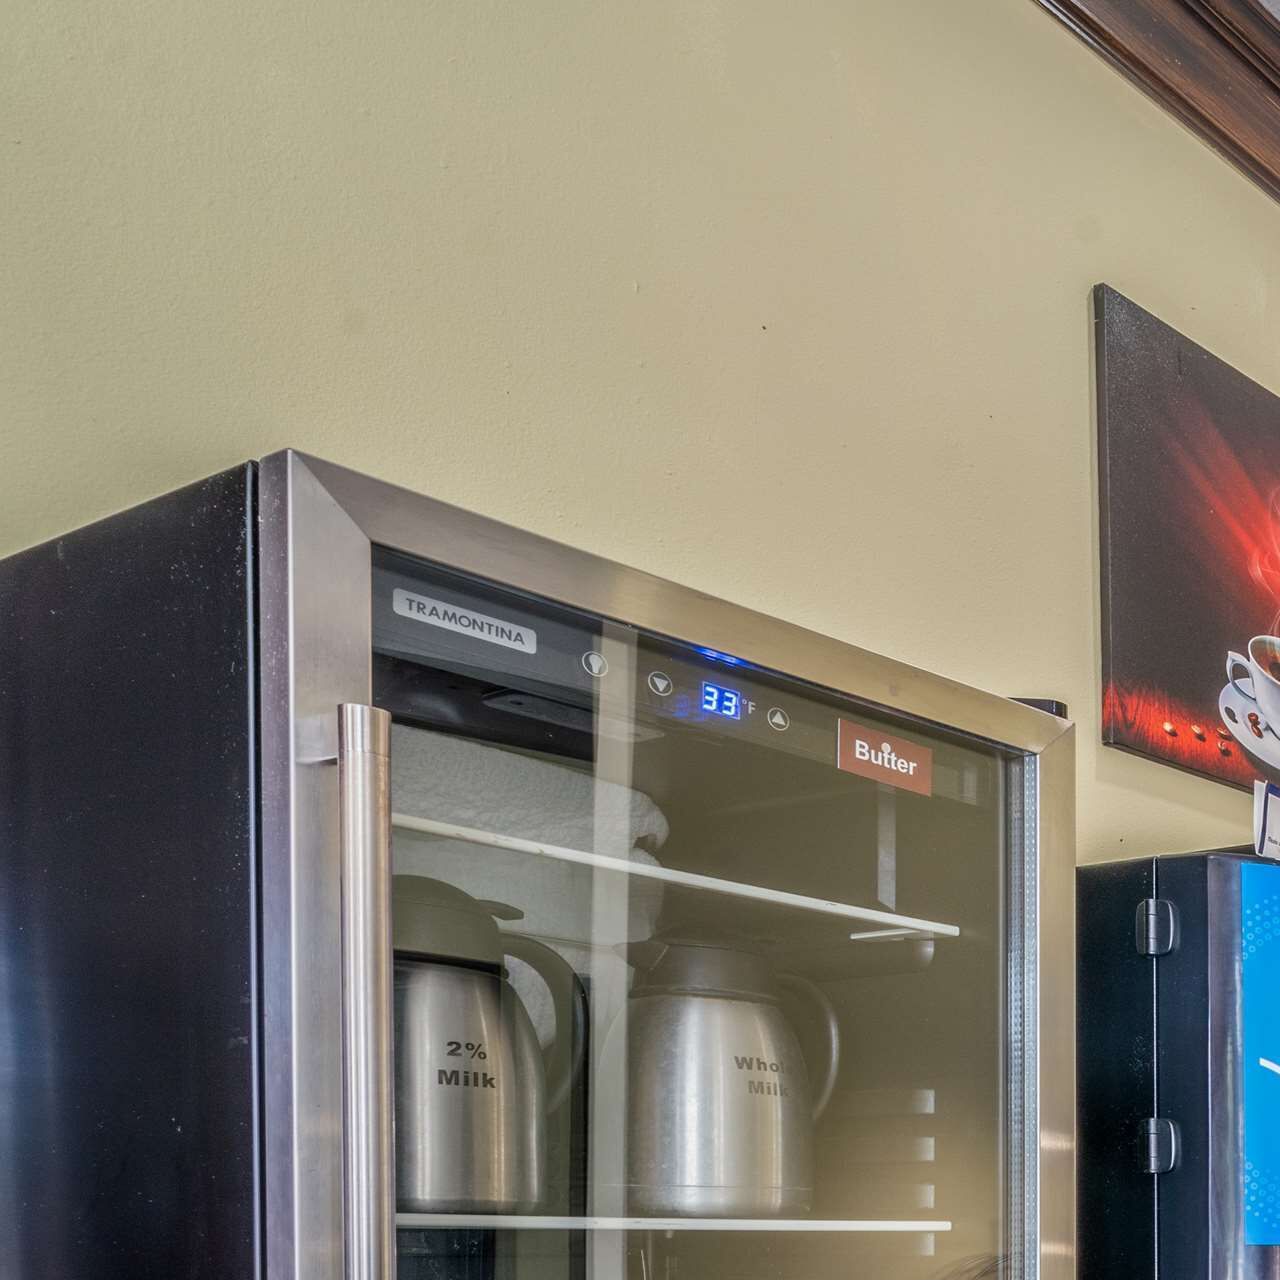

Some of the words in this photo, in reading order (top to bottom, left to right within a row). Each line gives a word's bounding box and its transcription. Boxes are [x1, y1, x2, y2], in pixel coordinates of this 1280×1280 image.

[405, 597, 526, 646] TRAMONTINA
[702, 685, 737, 717] 33
[854, 738, 918, 776] Butter
[445, 1040, 488, 1061] 2%
[733, 1055, 787, 1075] Whol
[437, 1068, 497, 1090] Milk
